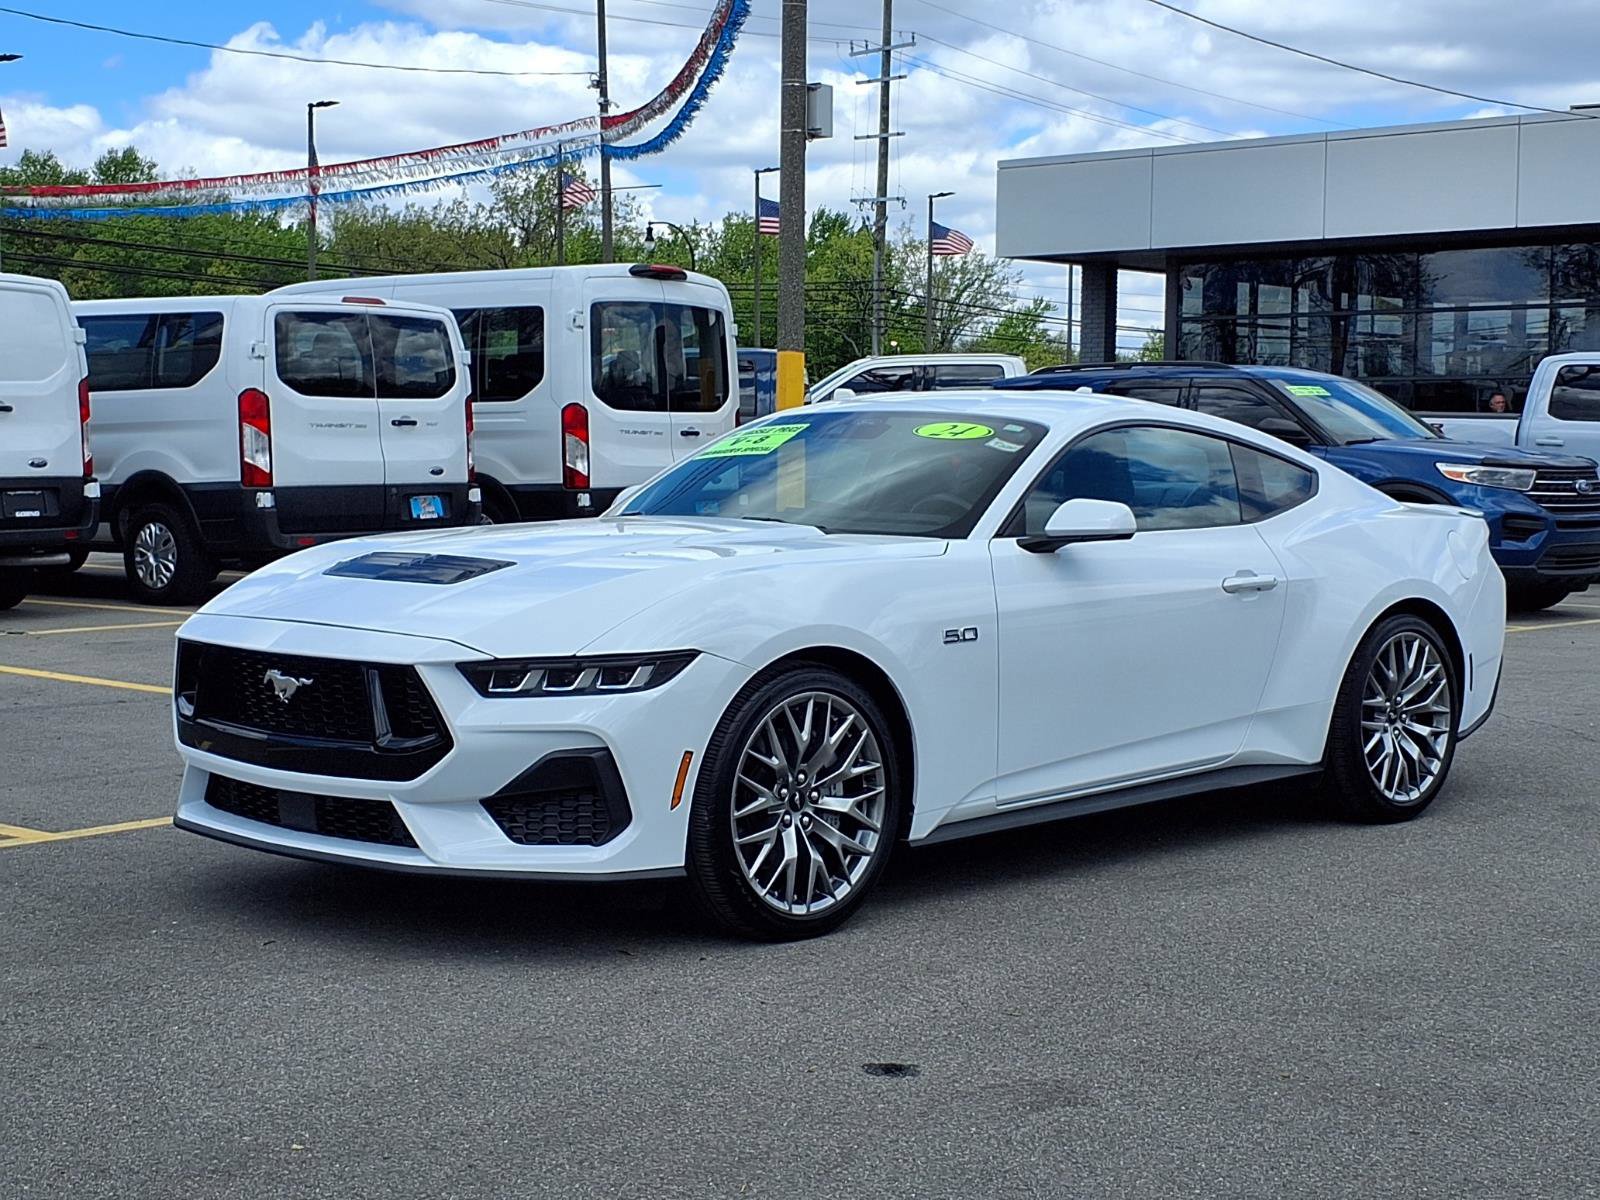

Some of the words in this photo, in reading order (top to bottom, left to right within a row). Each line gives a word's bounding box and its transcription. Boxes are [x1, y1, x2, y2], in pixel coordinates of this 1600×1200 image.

[928, 424, 979, 437] 24
[729, 435, 771, 446] V-8
[943, 627, 978, 644] 5.0
